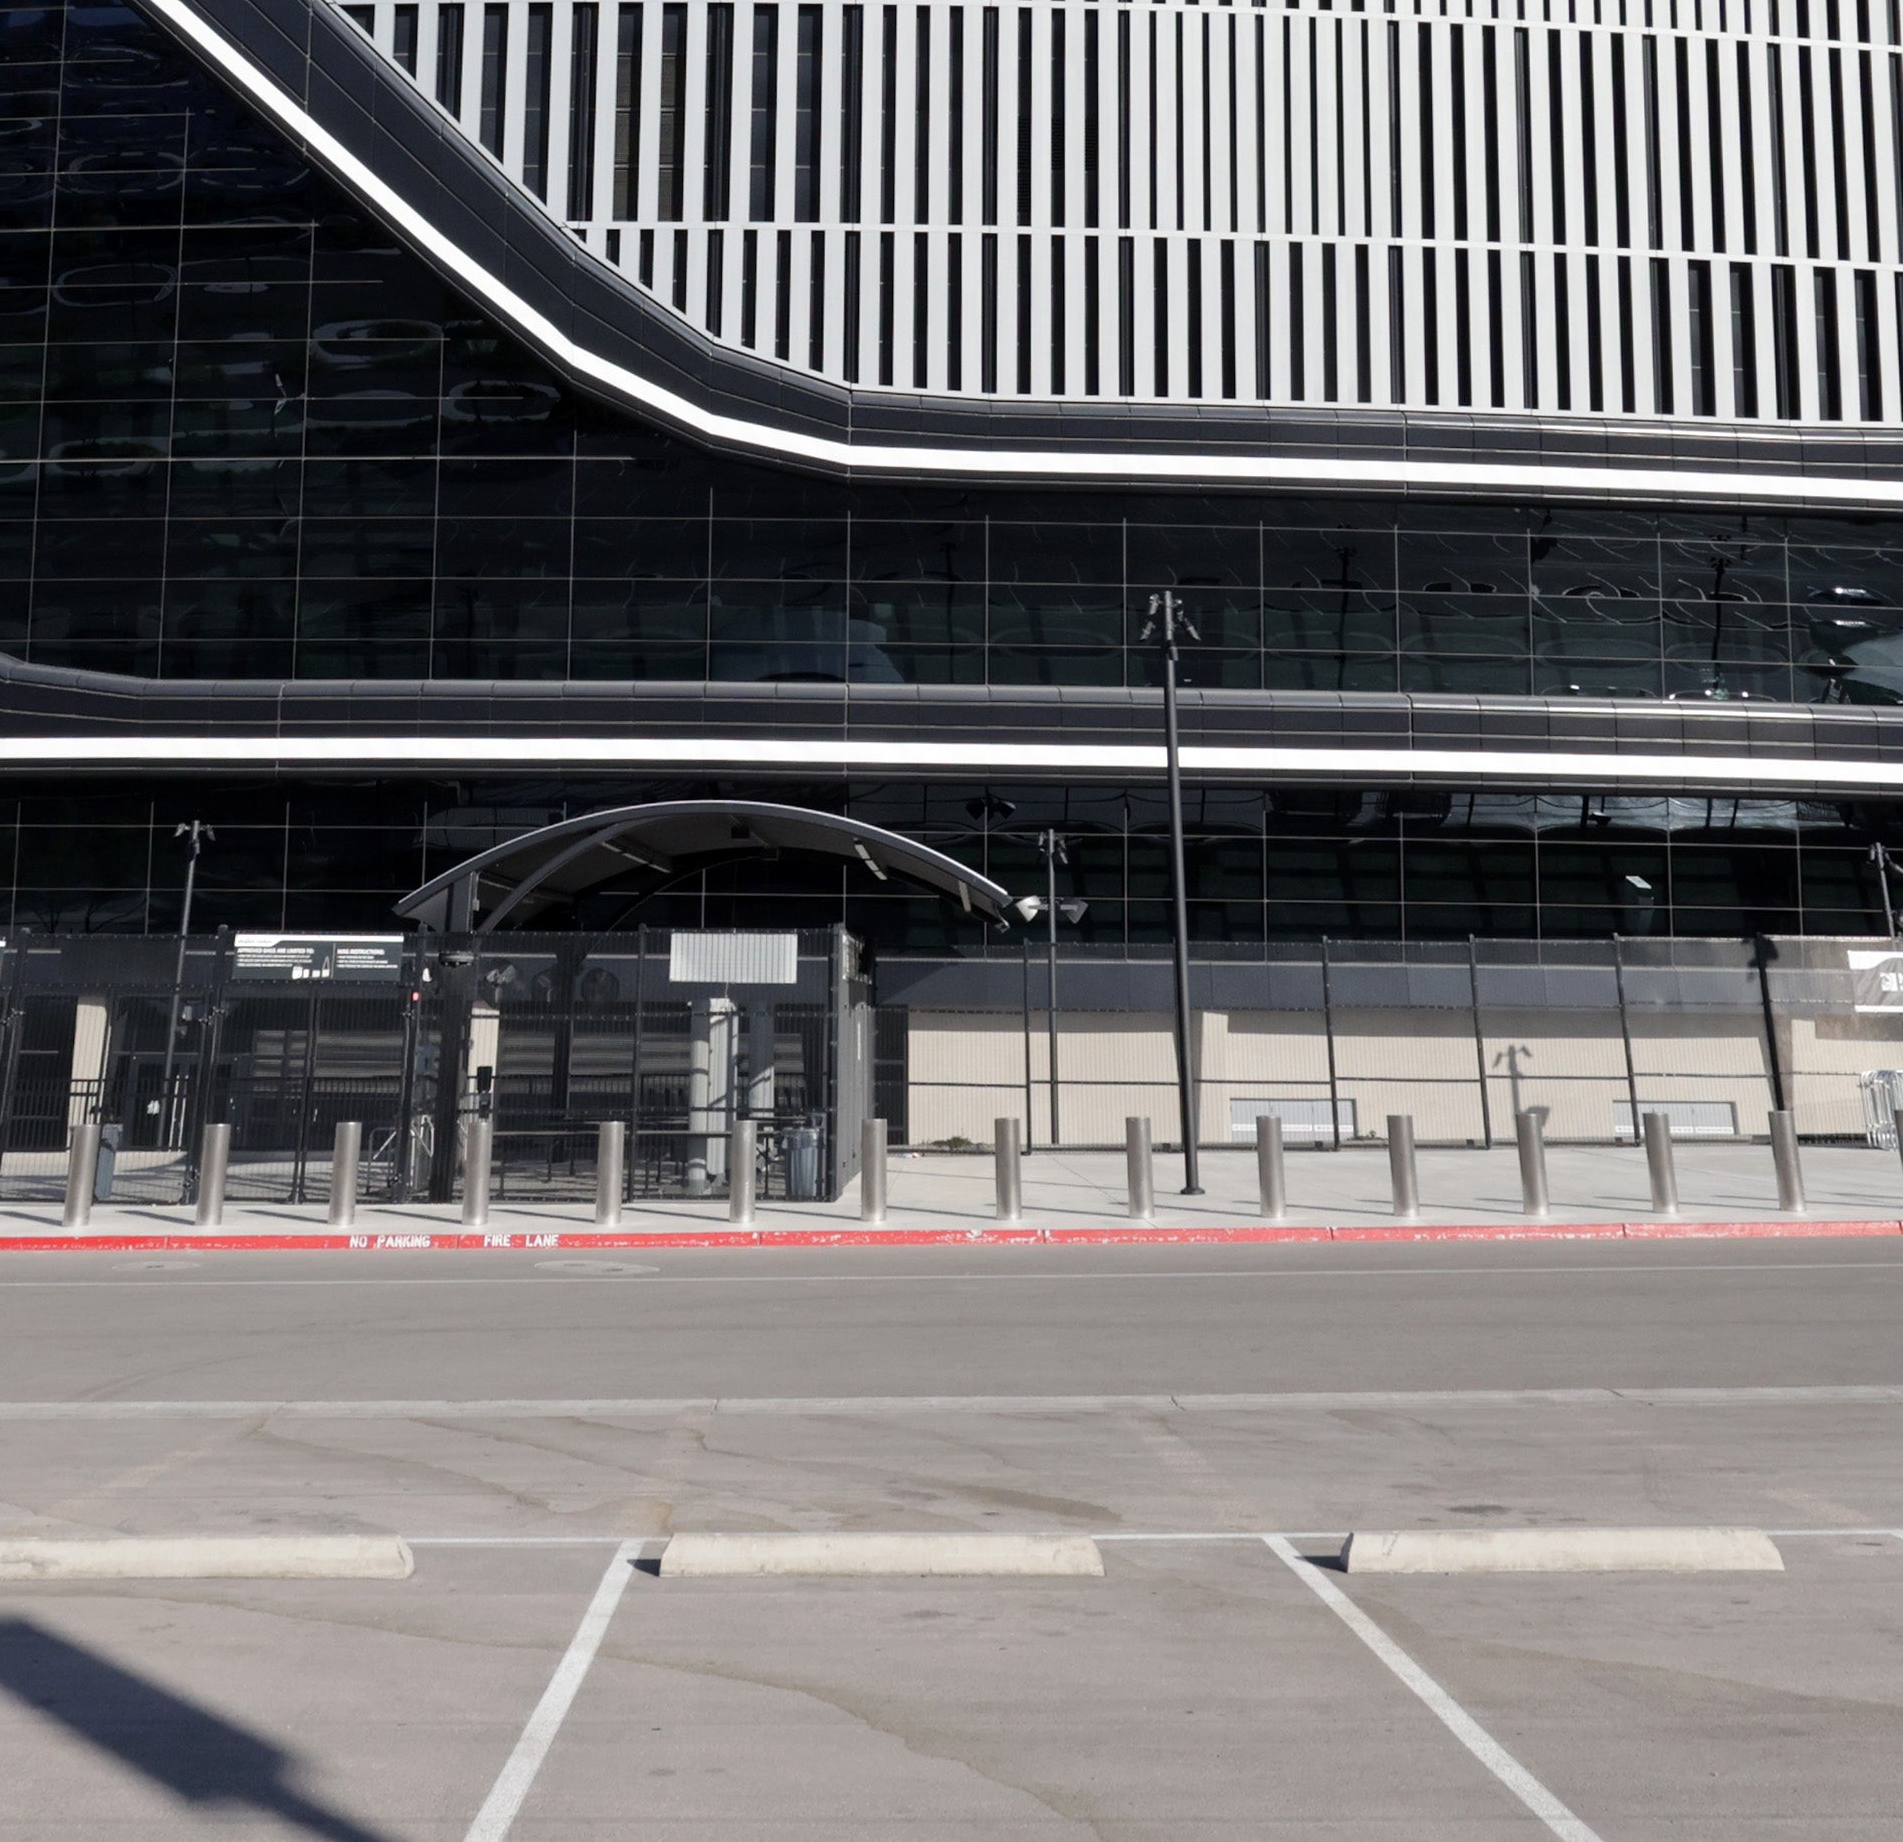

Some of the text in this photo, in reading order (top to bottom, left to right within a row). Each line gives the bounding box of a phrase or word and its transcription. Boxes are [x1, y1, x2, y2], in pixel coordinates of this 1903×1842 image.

[349, 1235, 560, 1249] NO PARKING FIRE LANE
